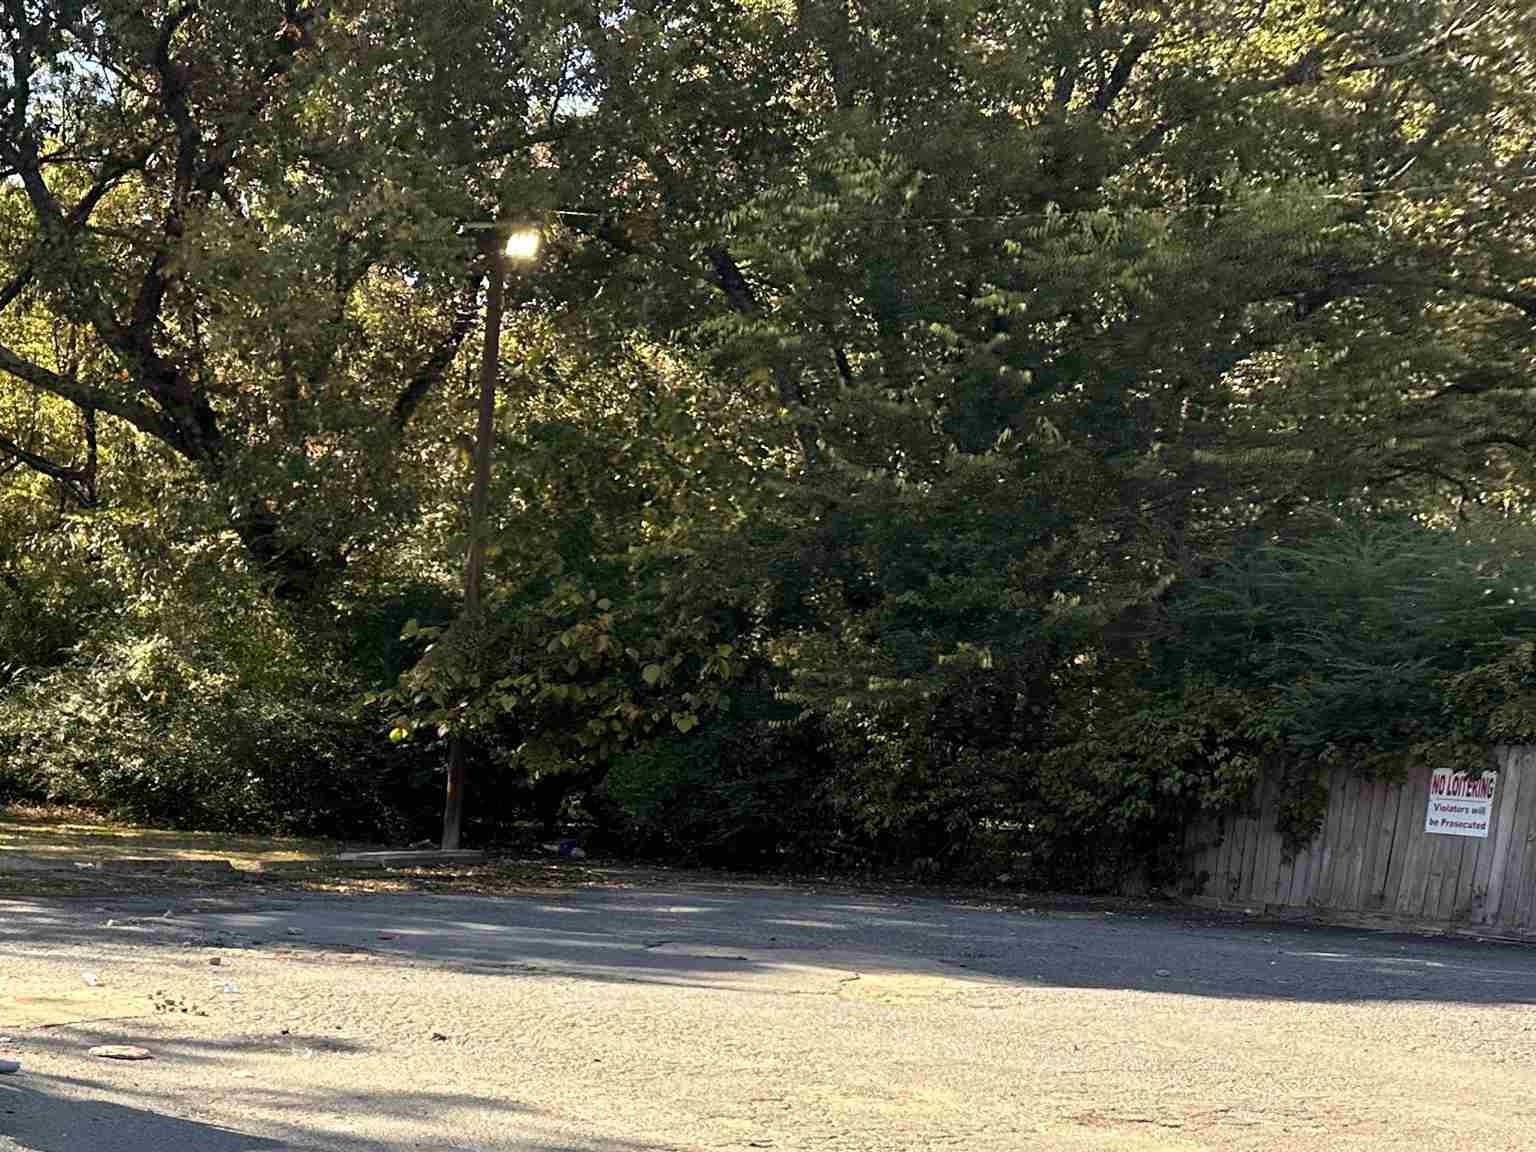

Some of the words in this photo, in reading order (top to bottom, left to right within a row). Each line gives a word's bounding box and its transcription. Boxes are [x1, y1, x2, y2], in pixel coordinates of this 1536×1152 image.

[1432, 774, 1445, 796] NO
[1446, 775, 1495, 799] LOITERING
[1433, 803, 1469, 814] Violators
[1471, 806, 1486, 815] will
[1429, 818, 1439, 826] be
[1440, 818, 1487, 830] Prosecuted
